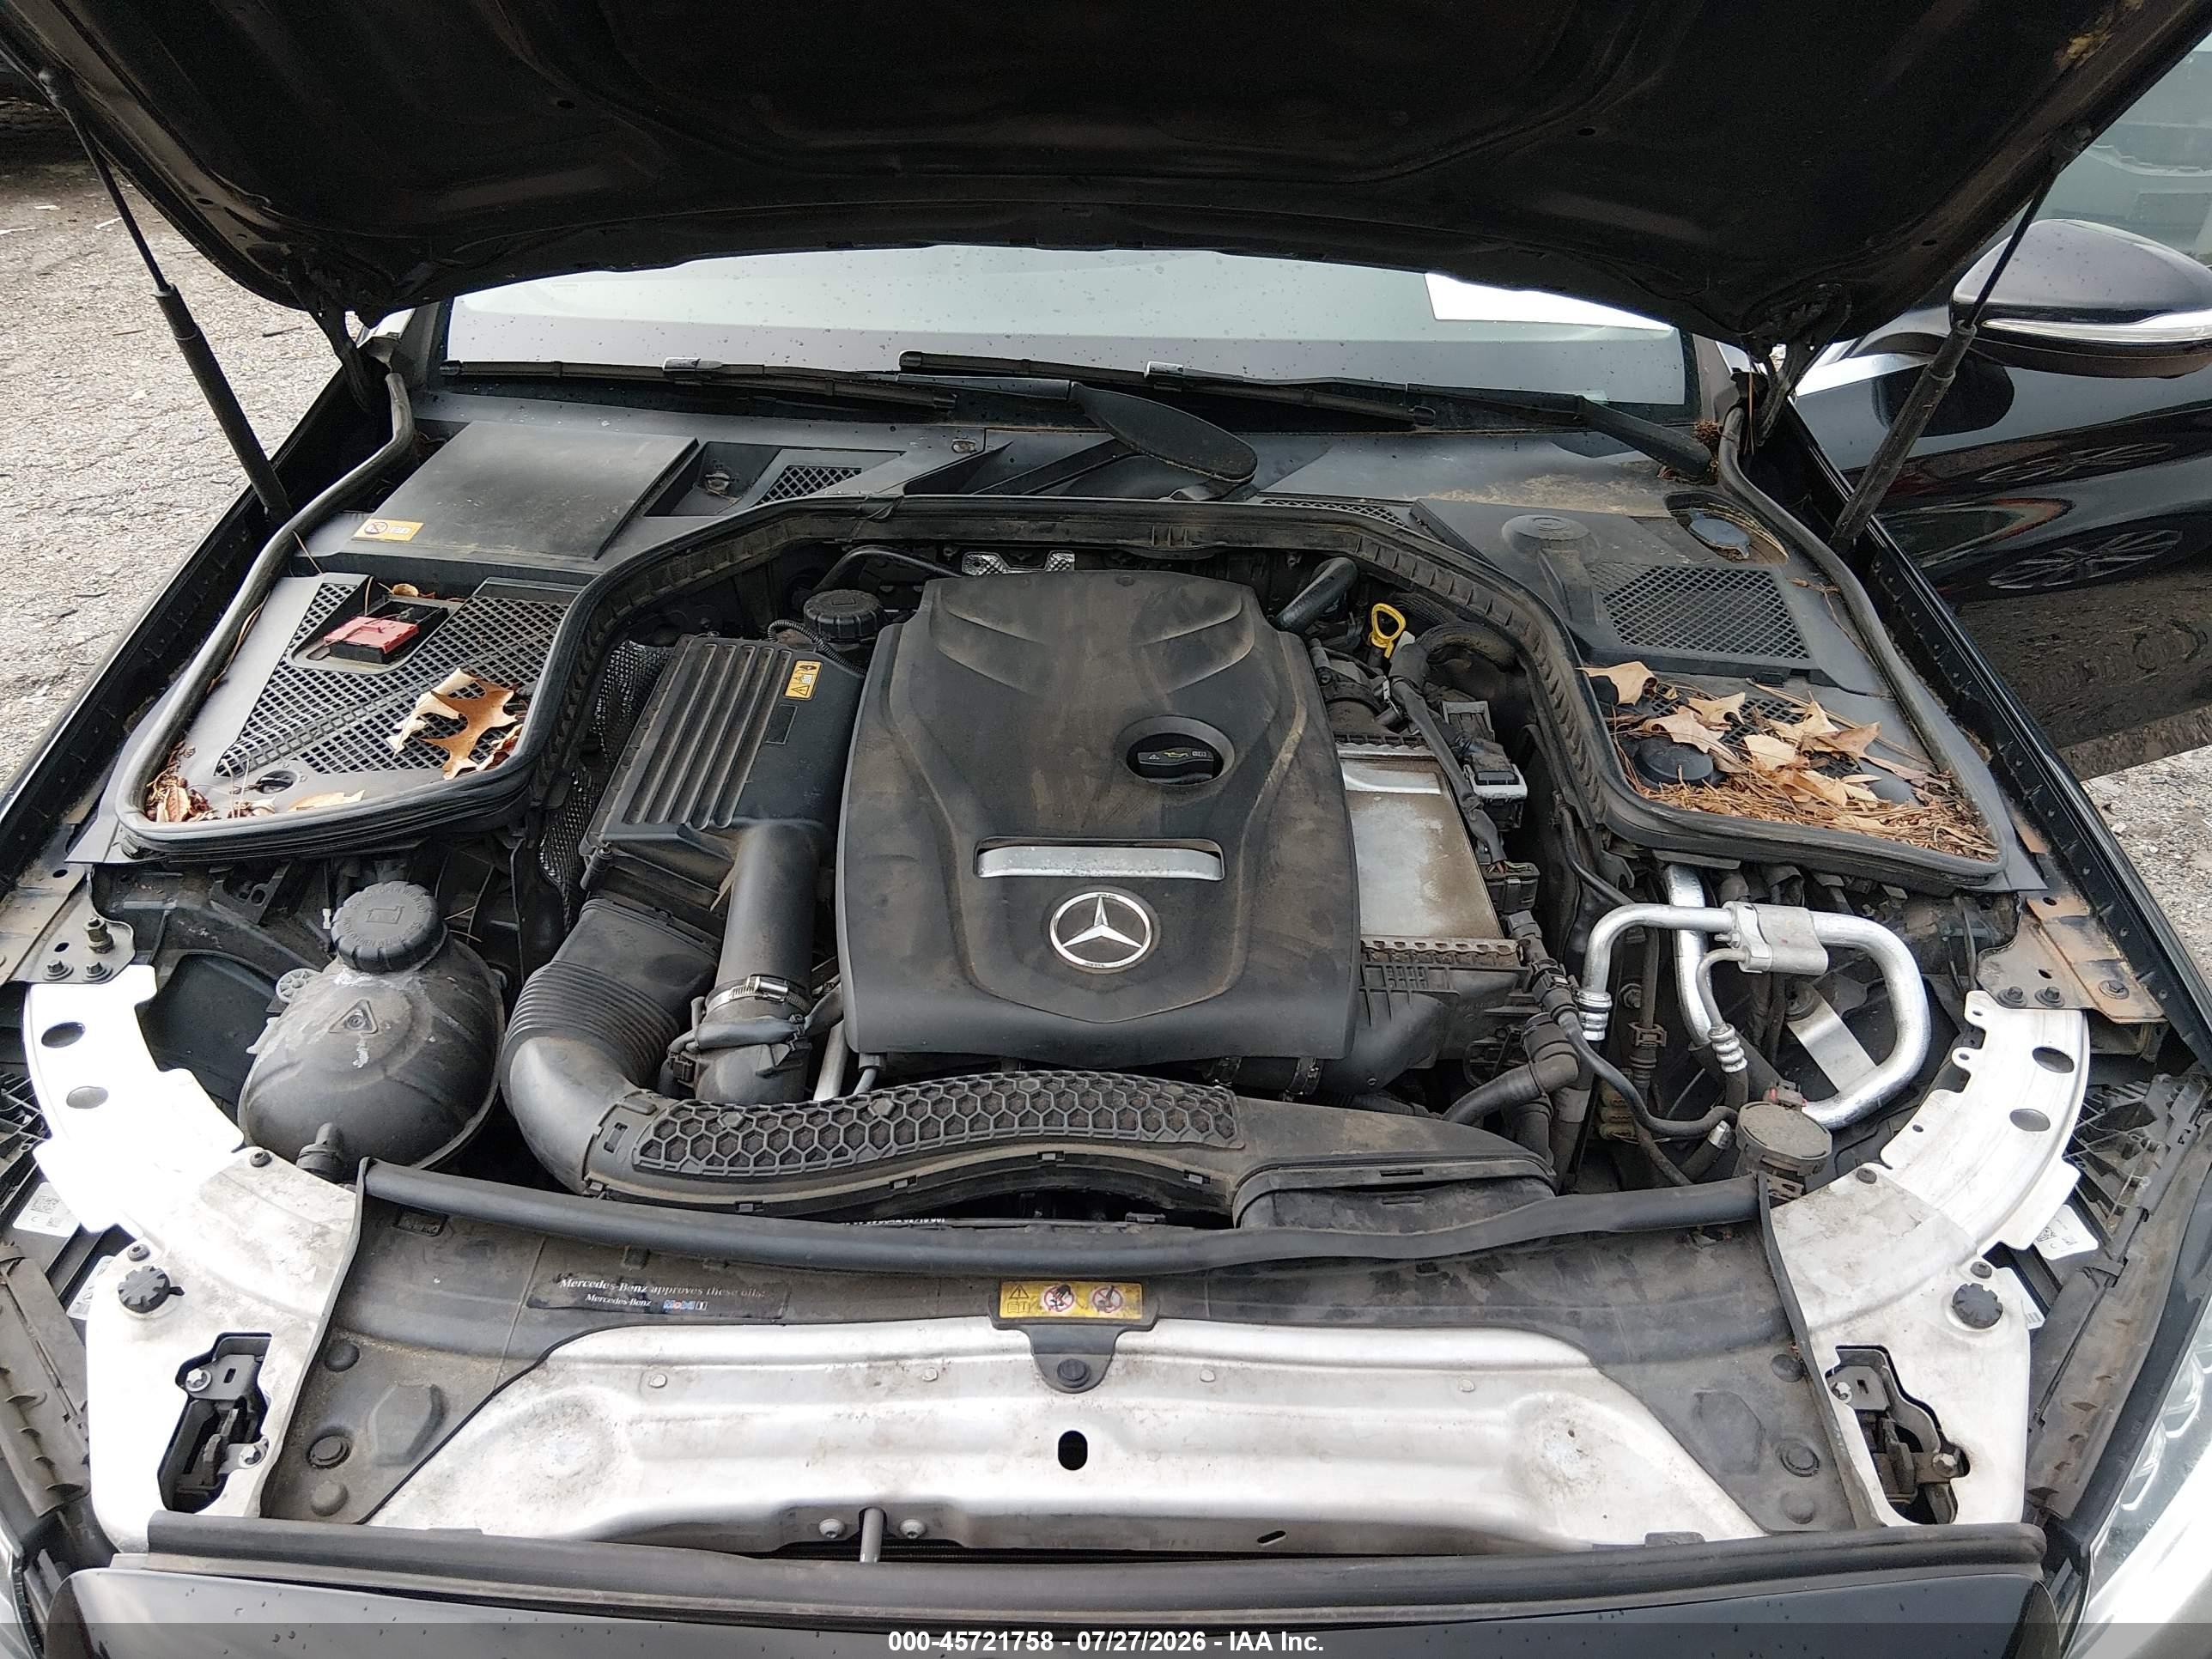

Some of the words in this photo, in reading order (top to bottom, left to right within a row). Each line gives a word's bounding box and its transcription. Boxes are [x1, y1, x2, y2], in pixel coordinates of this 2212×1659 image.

[560, 1279, 648, 1293] Mercedes-Benz
[650, 1286, 703, 1295] approves
[585, 1293, 653, 1306] Mercedes-Benz
